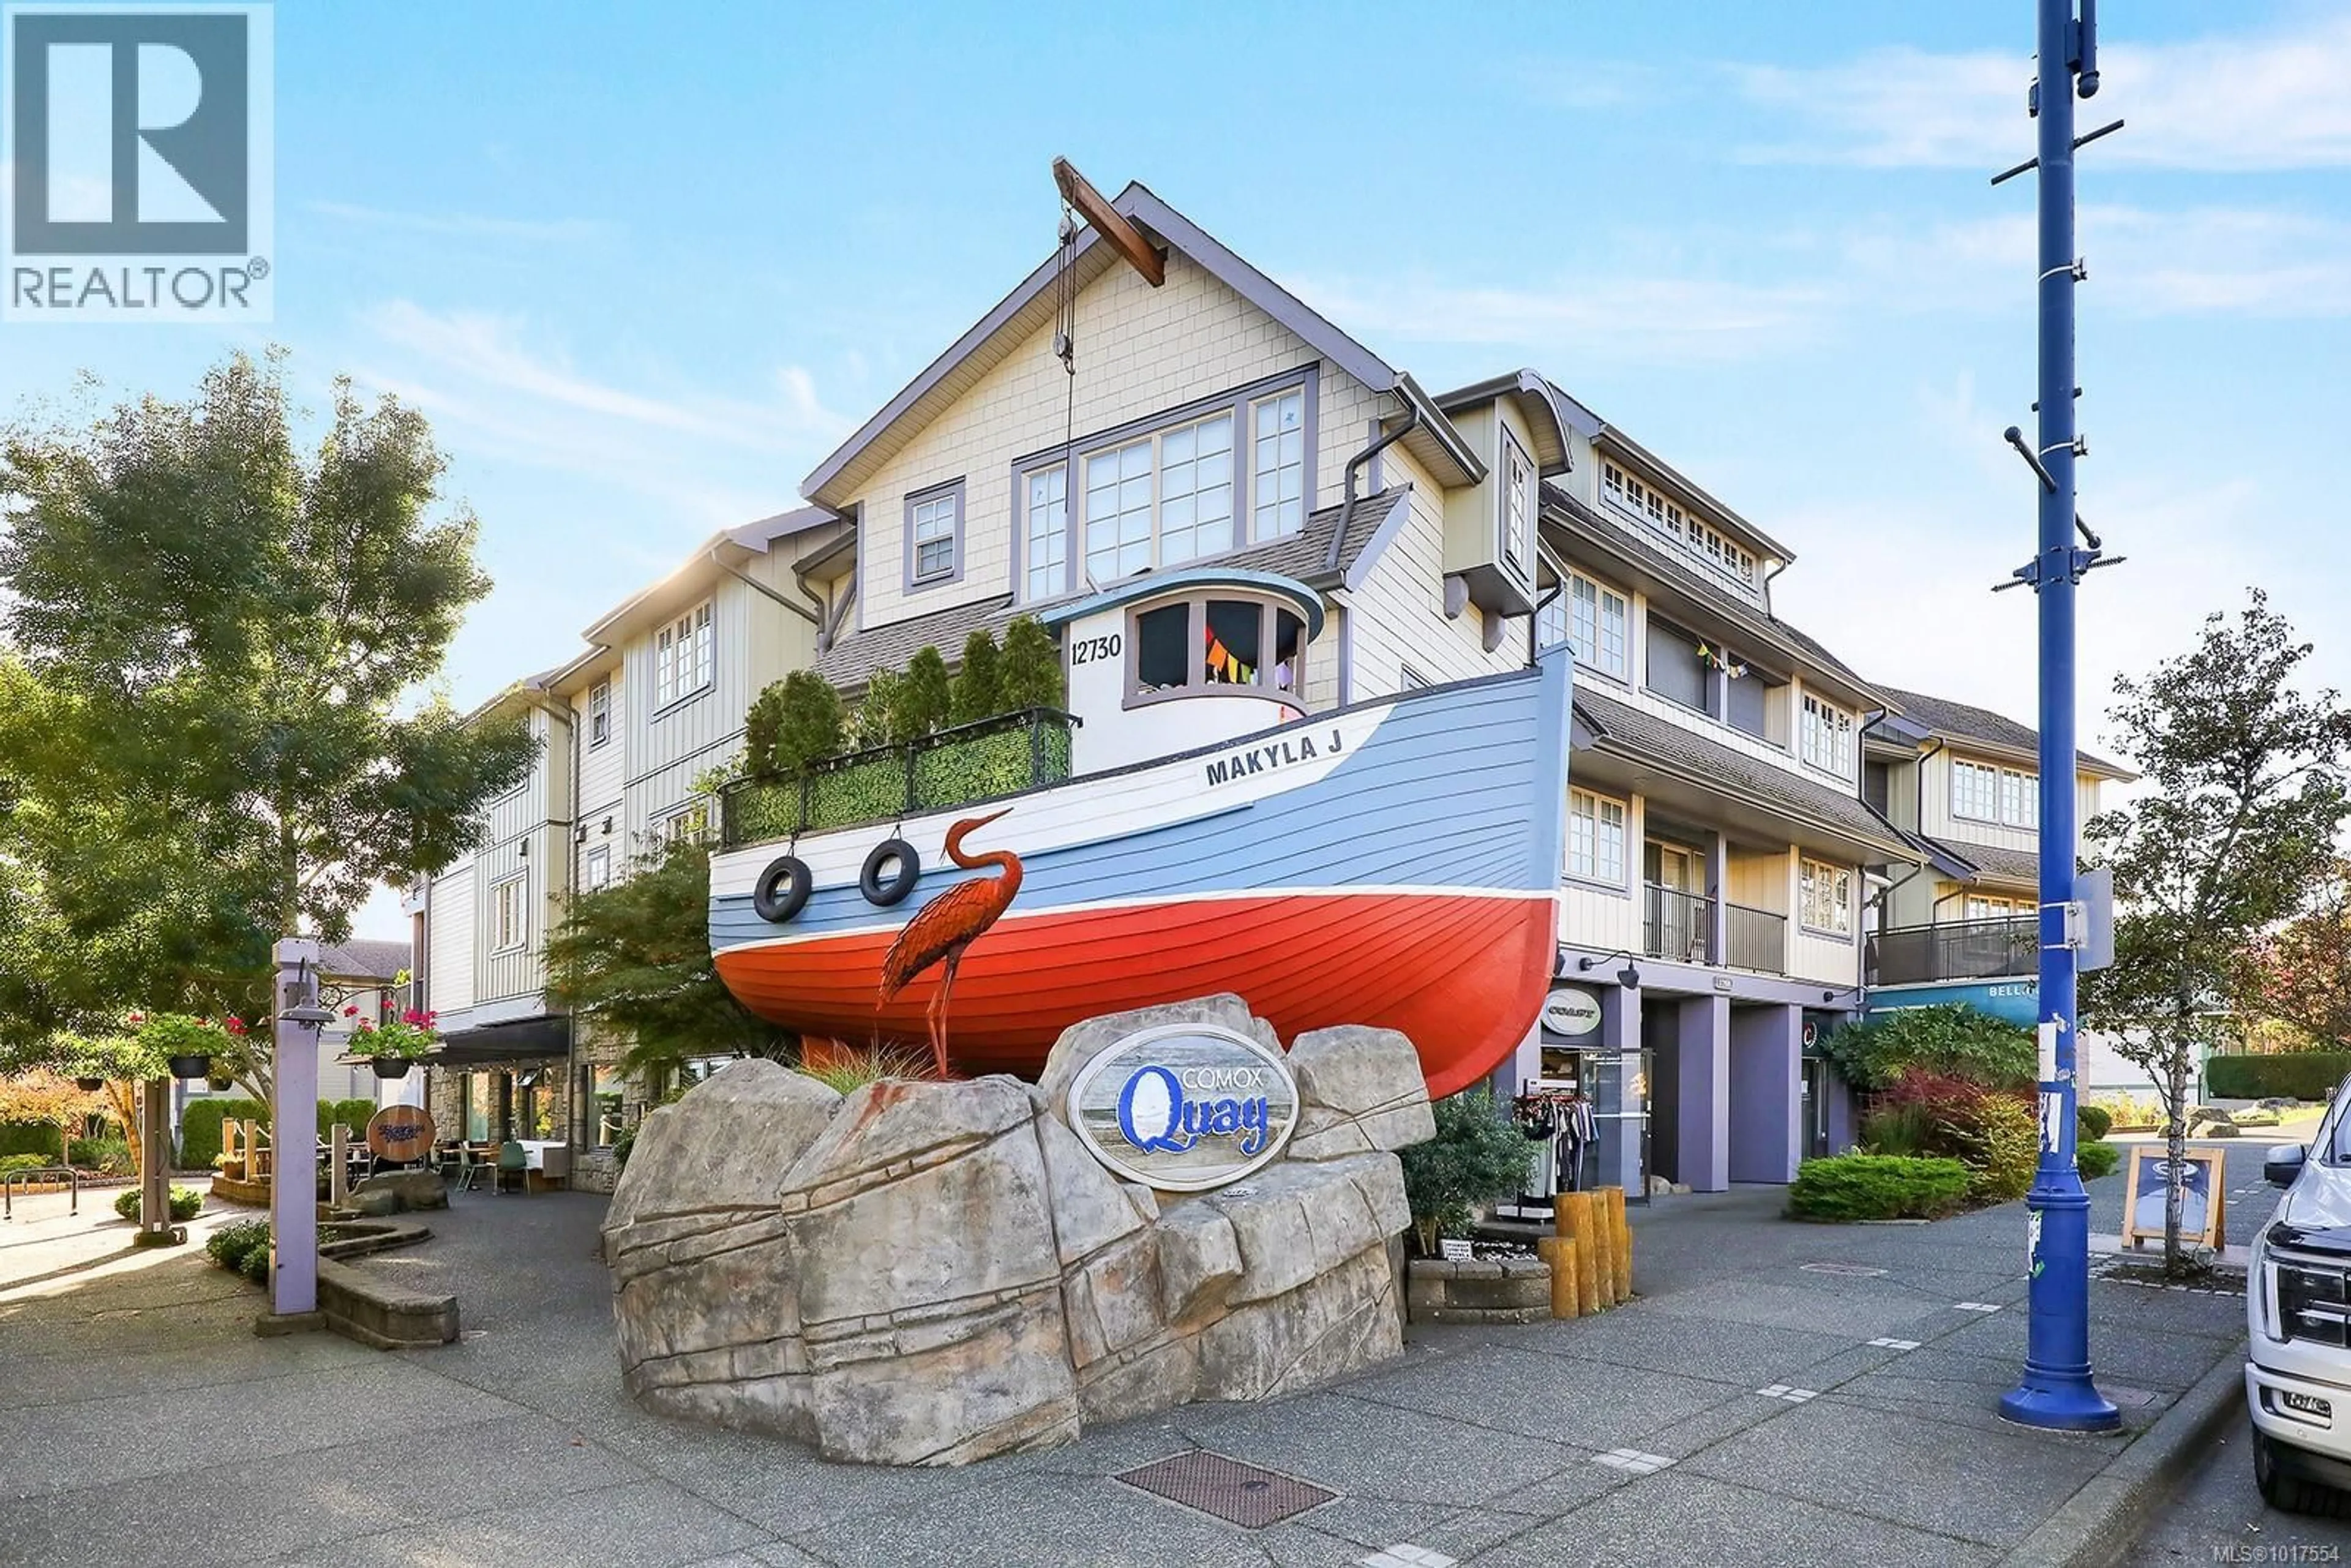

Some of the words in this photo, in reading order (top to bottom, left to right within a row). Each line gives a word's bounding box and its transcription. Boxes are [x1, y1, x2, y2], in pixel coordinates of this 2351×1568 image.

[1071, 634, 1121, 666] 12730
[1206, 736, 1318, 786] MAKYLA
[1328, 729, 1343, 754] J
[1182, 1067, 1264, 1089] COMOX
[1116, 1063, 1267, 1157] Quay
